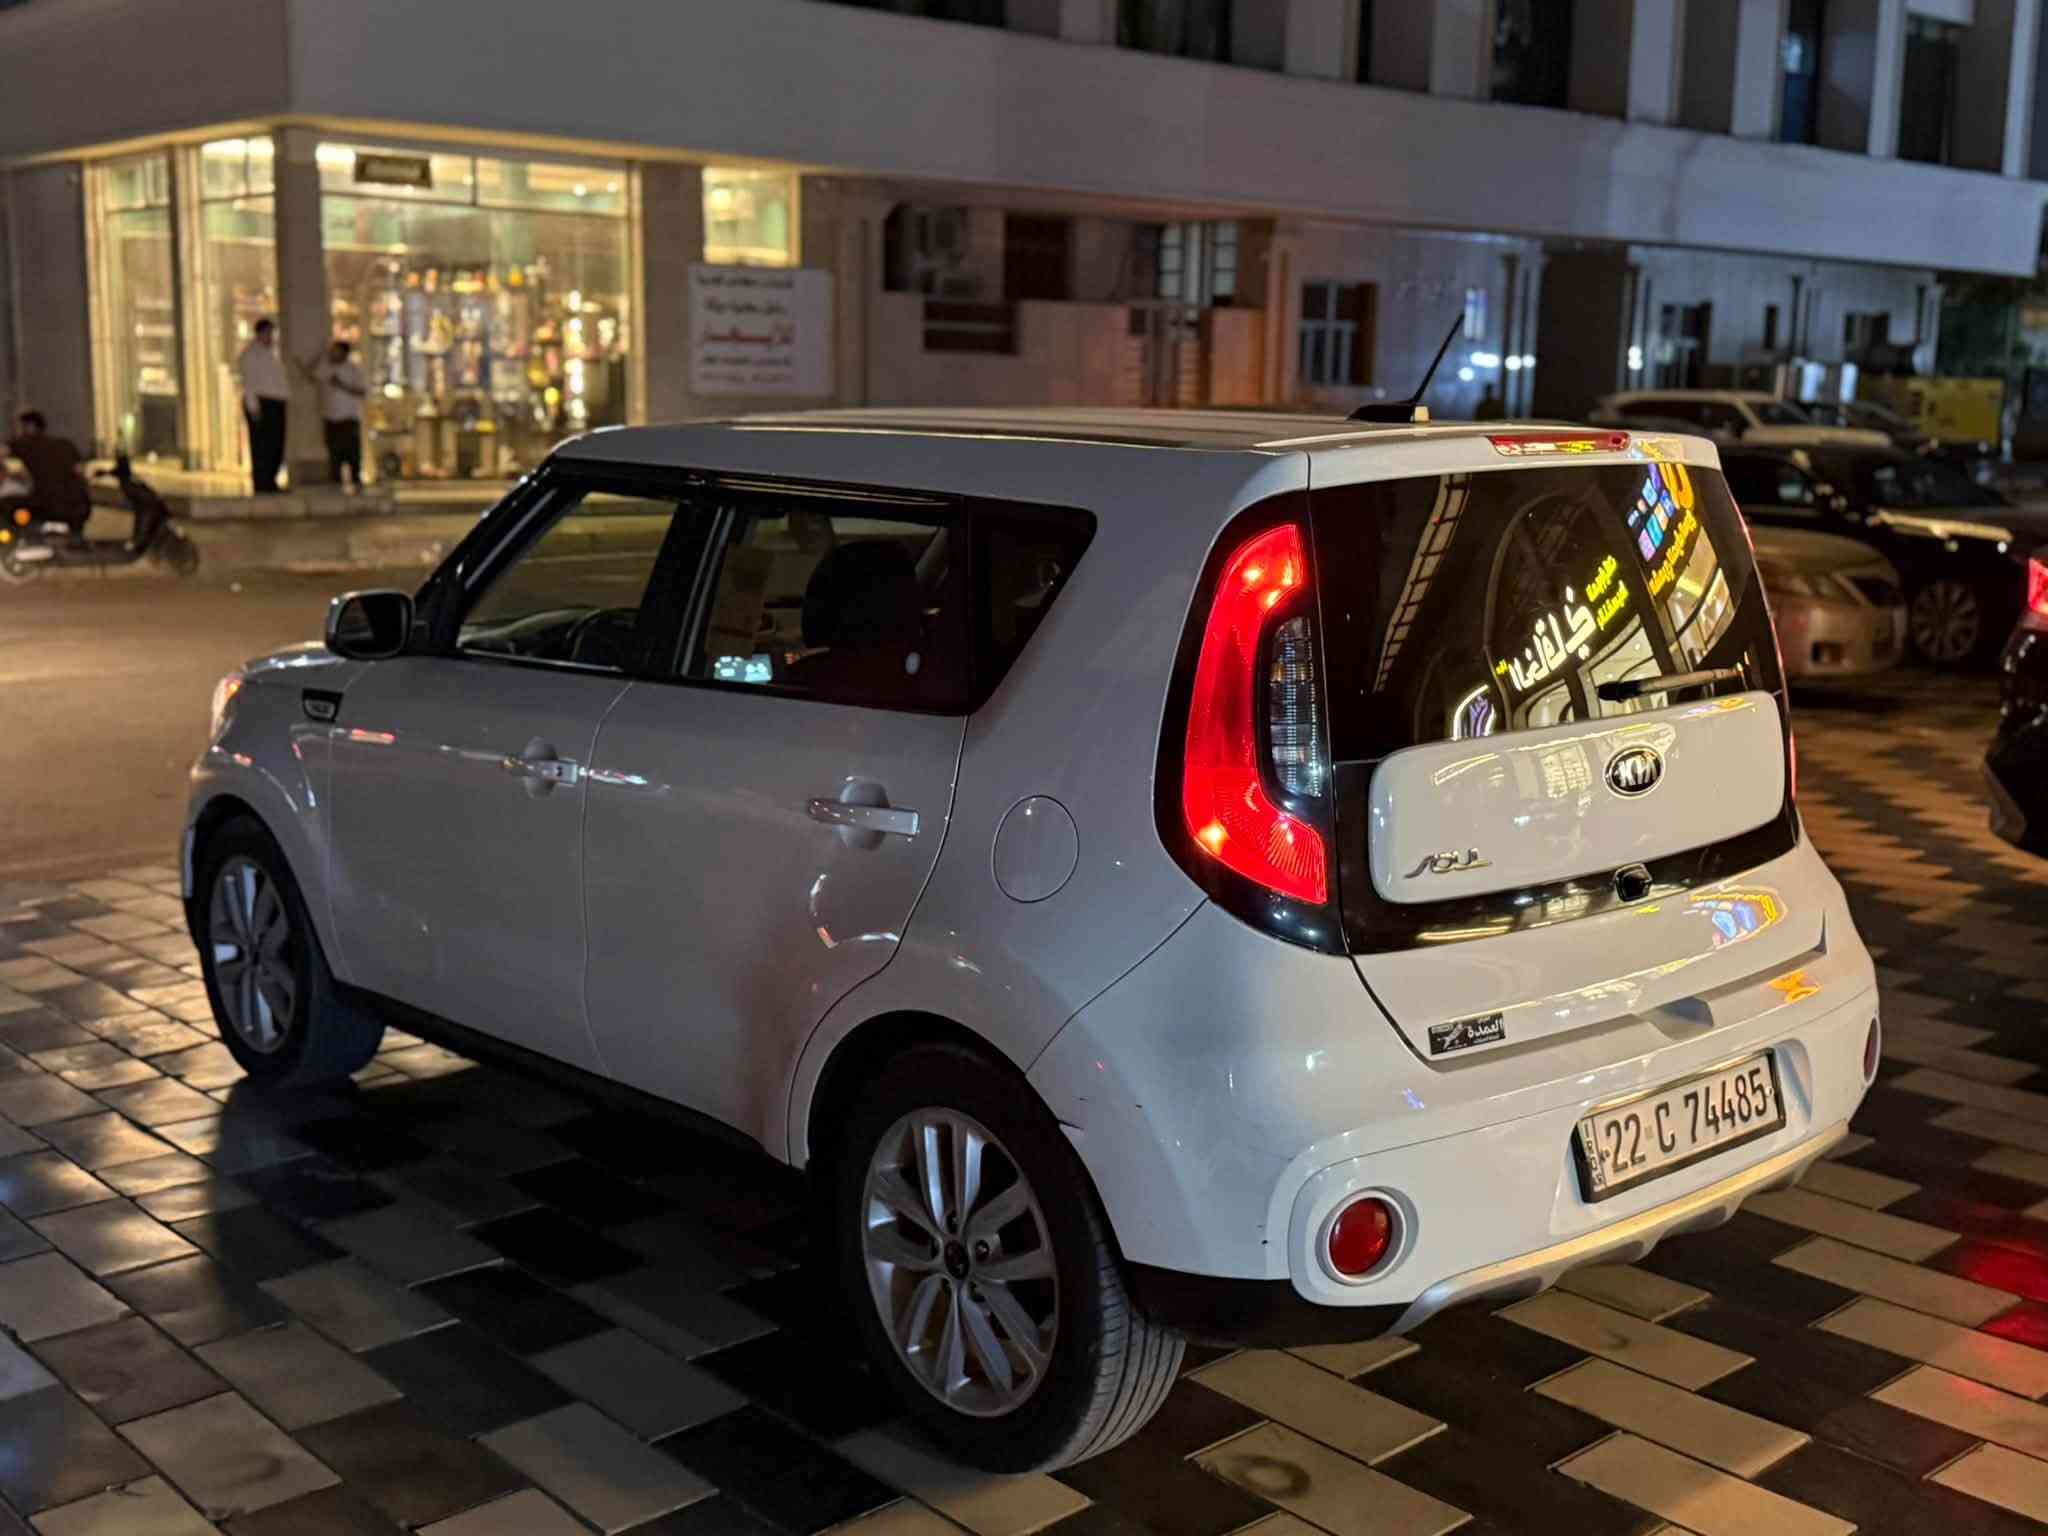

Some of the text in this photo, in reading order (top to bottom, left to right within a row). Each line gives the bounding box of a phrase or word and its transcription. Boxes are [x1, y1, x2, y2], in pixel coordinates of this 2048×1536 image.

[1605, 1067, 1769, 1174] 22 C 74485
